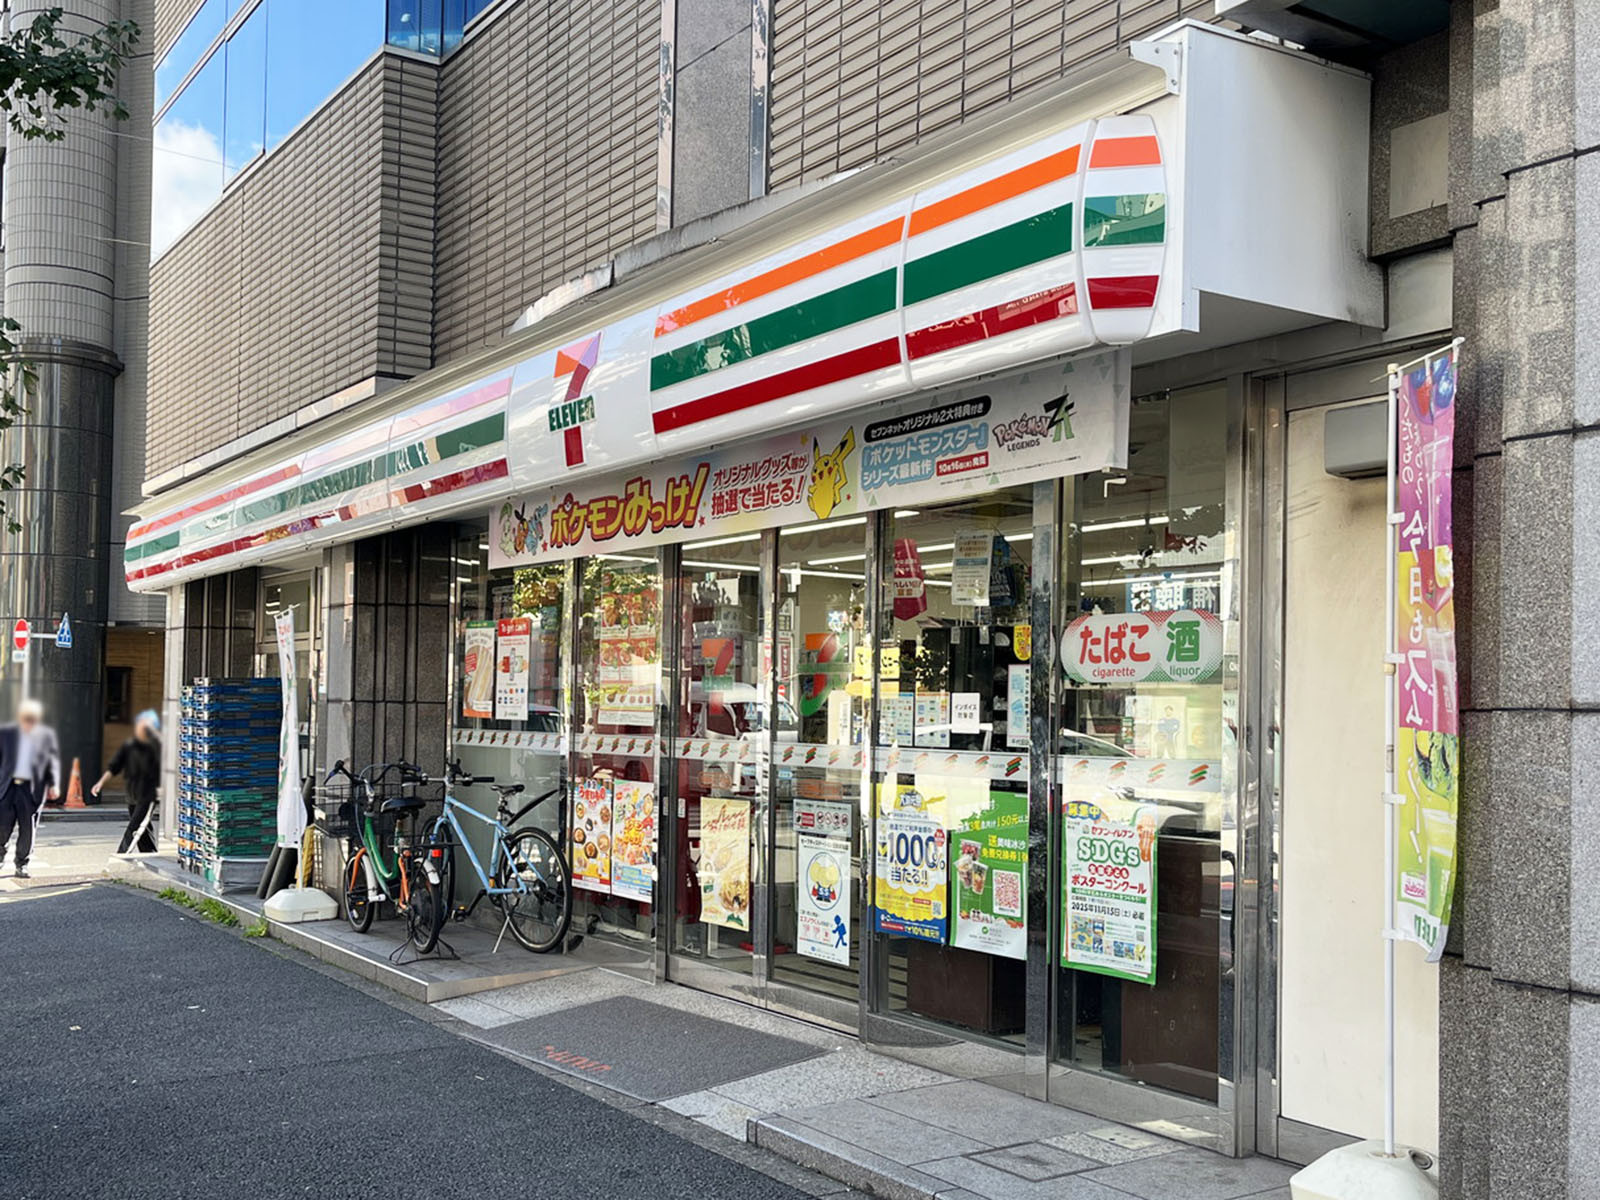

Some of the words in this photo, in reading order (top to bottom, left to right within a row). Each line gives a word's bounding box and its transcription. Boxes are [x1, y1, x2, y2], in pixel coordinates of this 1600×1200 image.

[1007, 438, 1040, 452] LEGENDS
[711, 475, 805, 516] 抽選で当たる!
[1079, 622, 1151, 664] たばこ
[1166, 620, 1201, 663] 酒
[1092, 665, 1136, 679] cigarette
[1169, 664, 1201, 677] liquor
[1077, 836, 1141, 868] SDGs
[1071, 874, 1147, 895] ポスターコンクール
